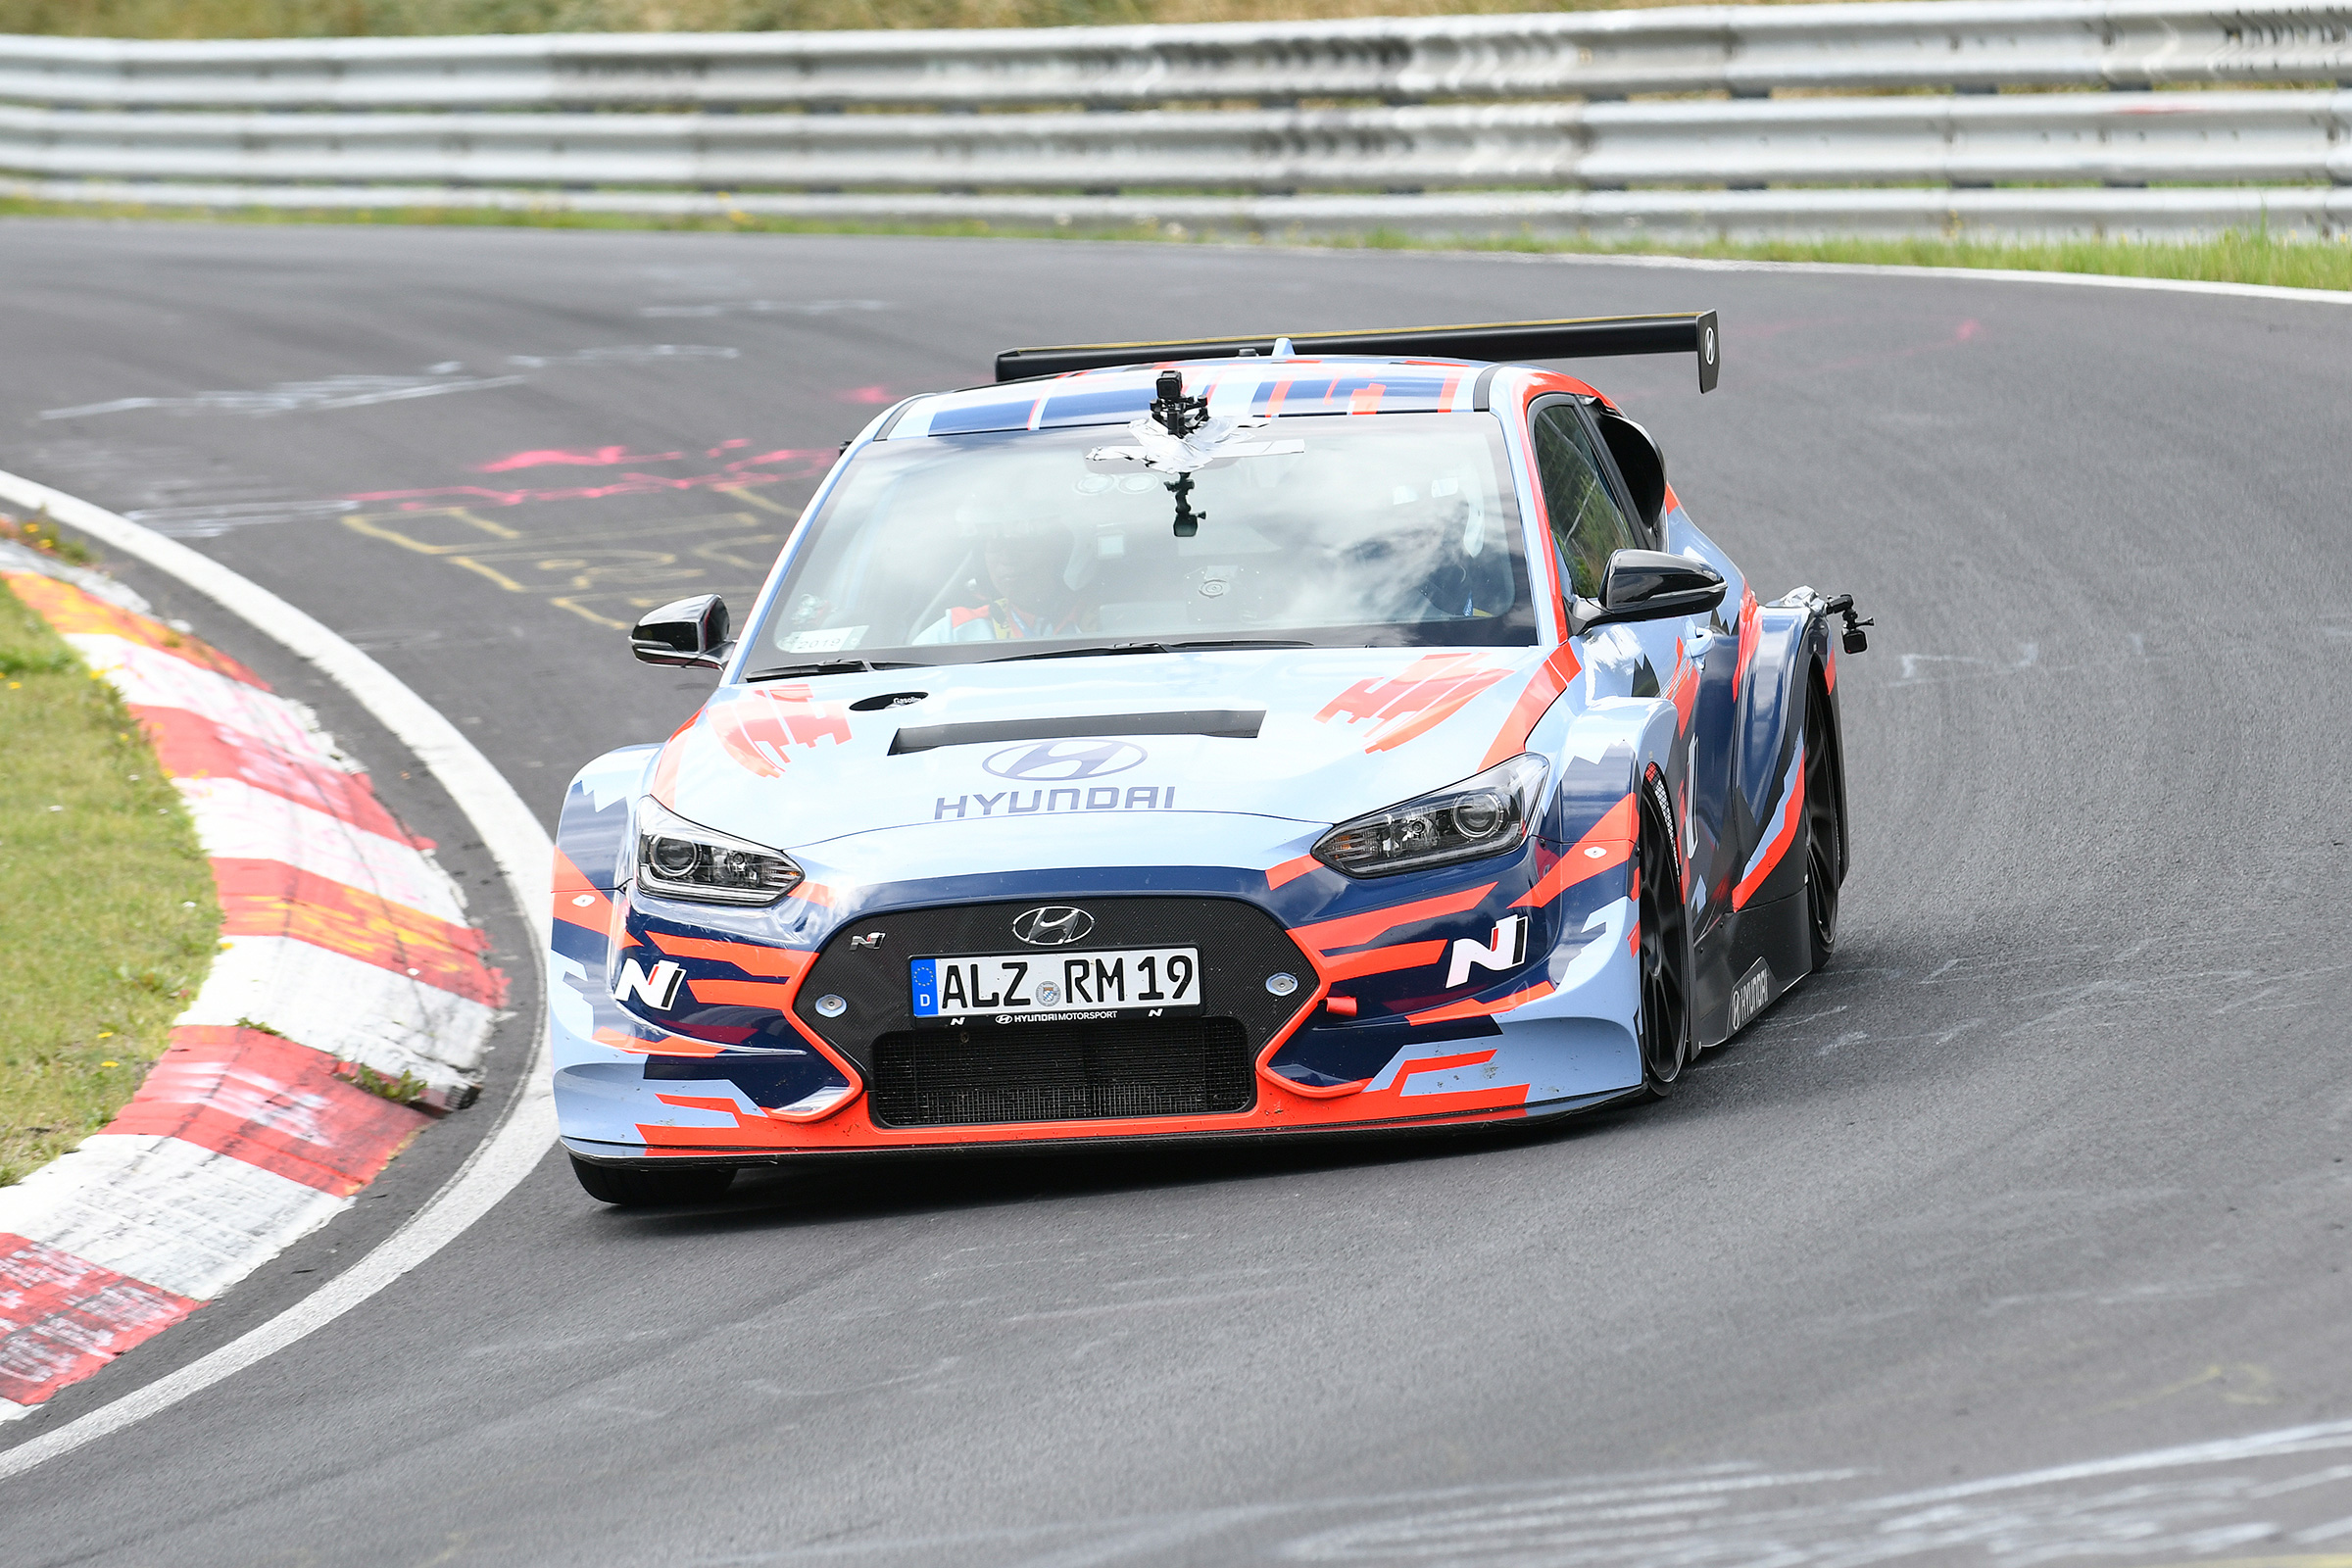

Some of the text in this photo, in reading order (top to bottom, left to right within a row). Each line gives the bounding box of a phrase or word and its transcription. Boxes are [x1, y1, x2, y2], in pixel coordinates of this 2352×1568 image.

[797, 637, 841, 650] 2019
[934, 786, 1176, 820] HYUNDAI
[941, 960, 1031, 1009] ALZ
[1064, 956, 1126, 1004] RM
[1137, 955, 1194, 1001] 19
[1740, 967, 1769, 1022] HYUNDAI
[919, 994, 931, 1007] D
